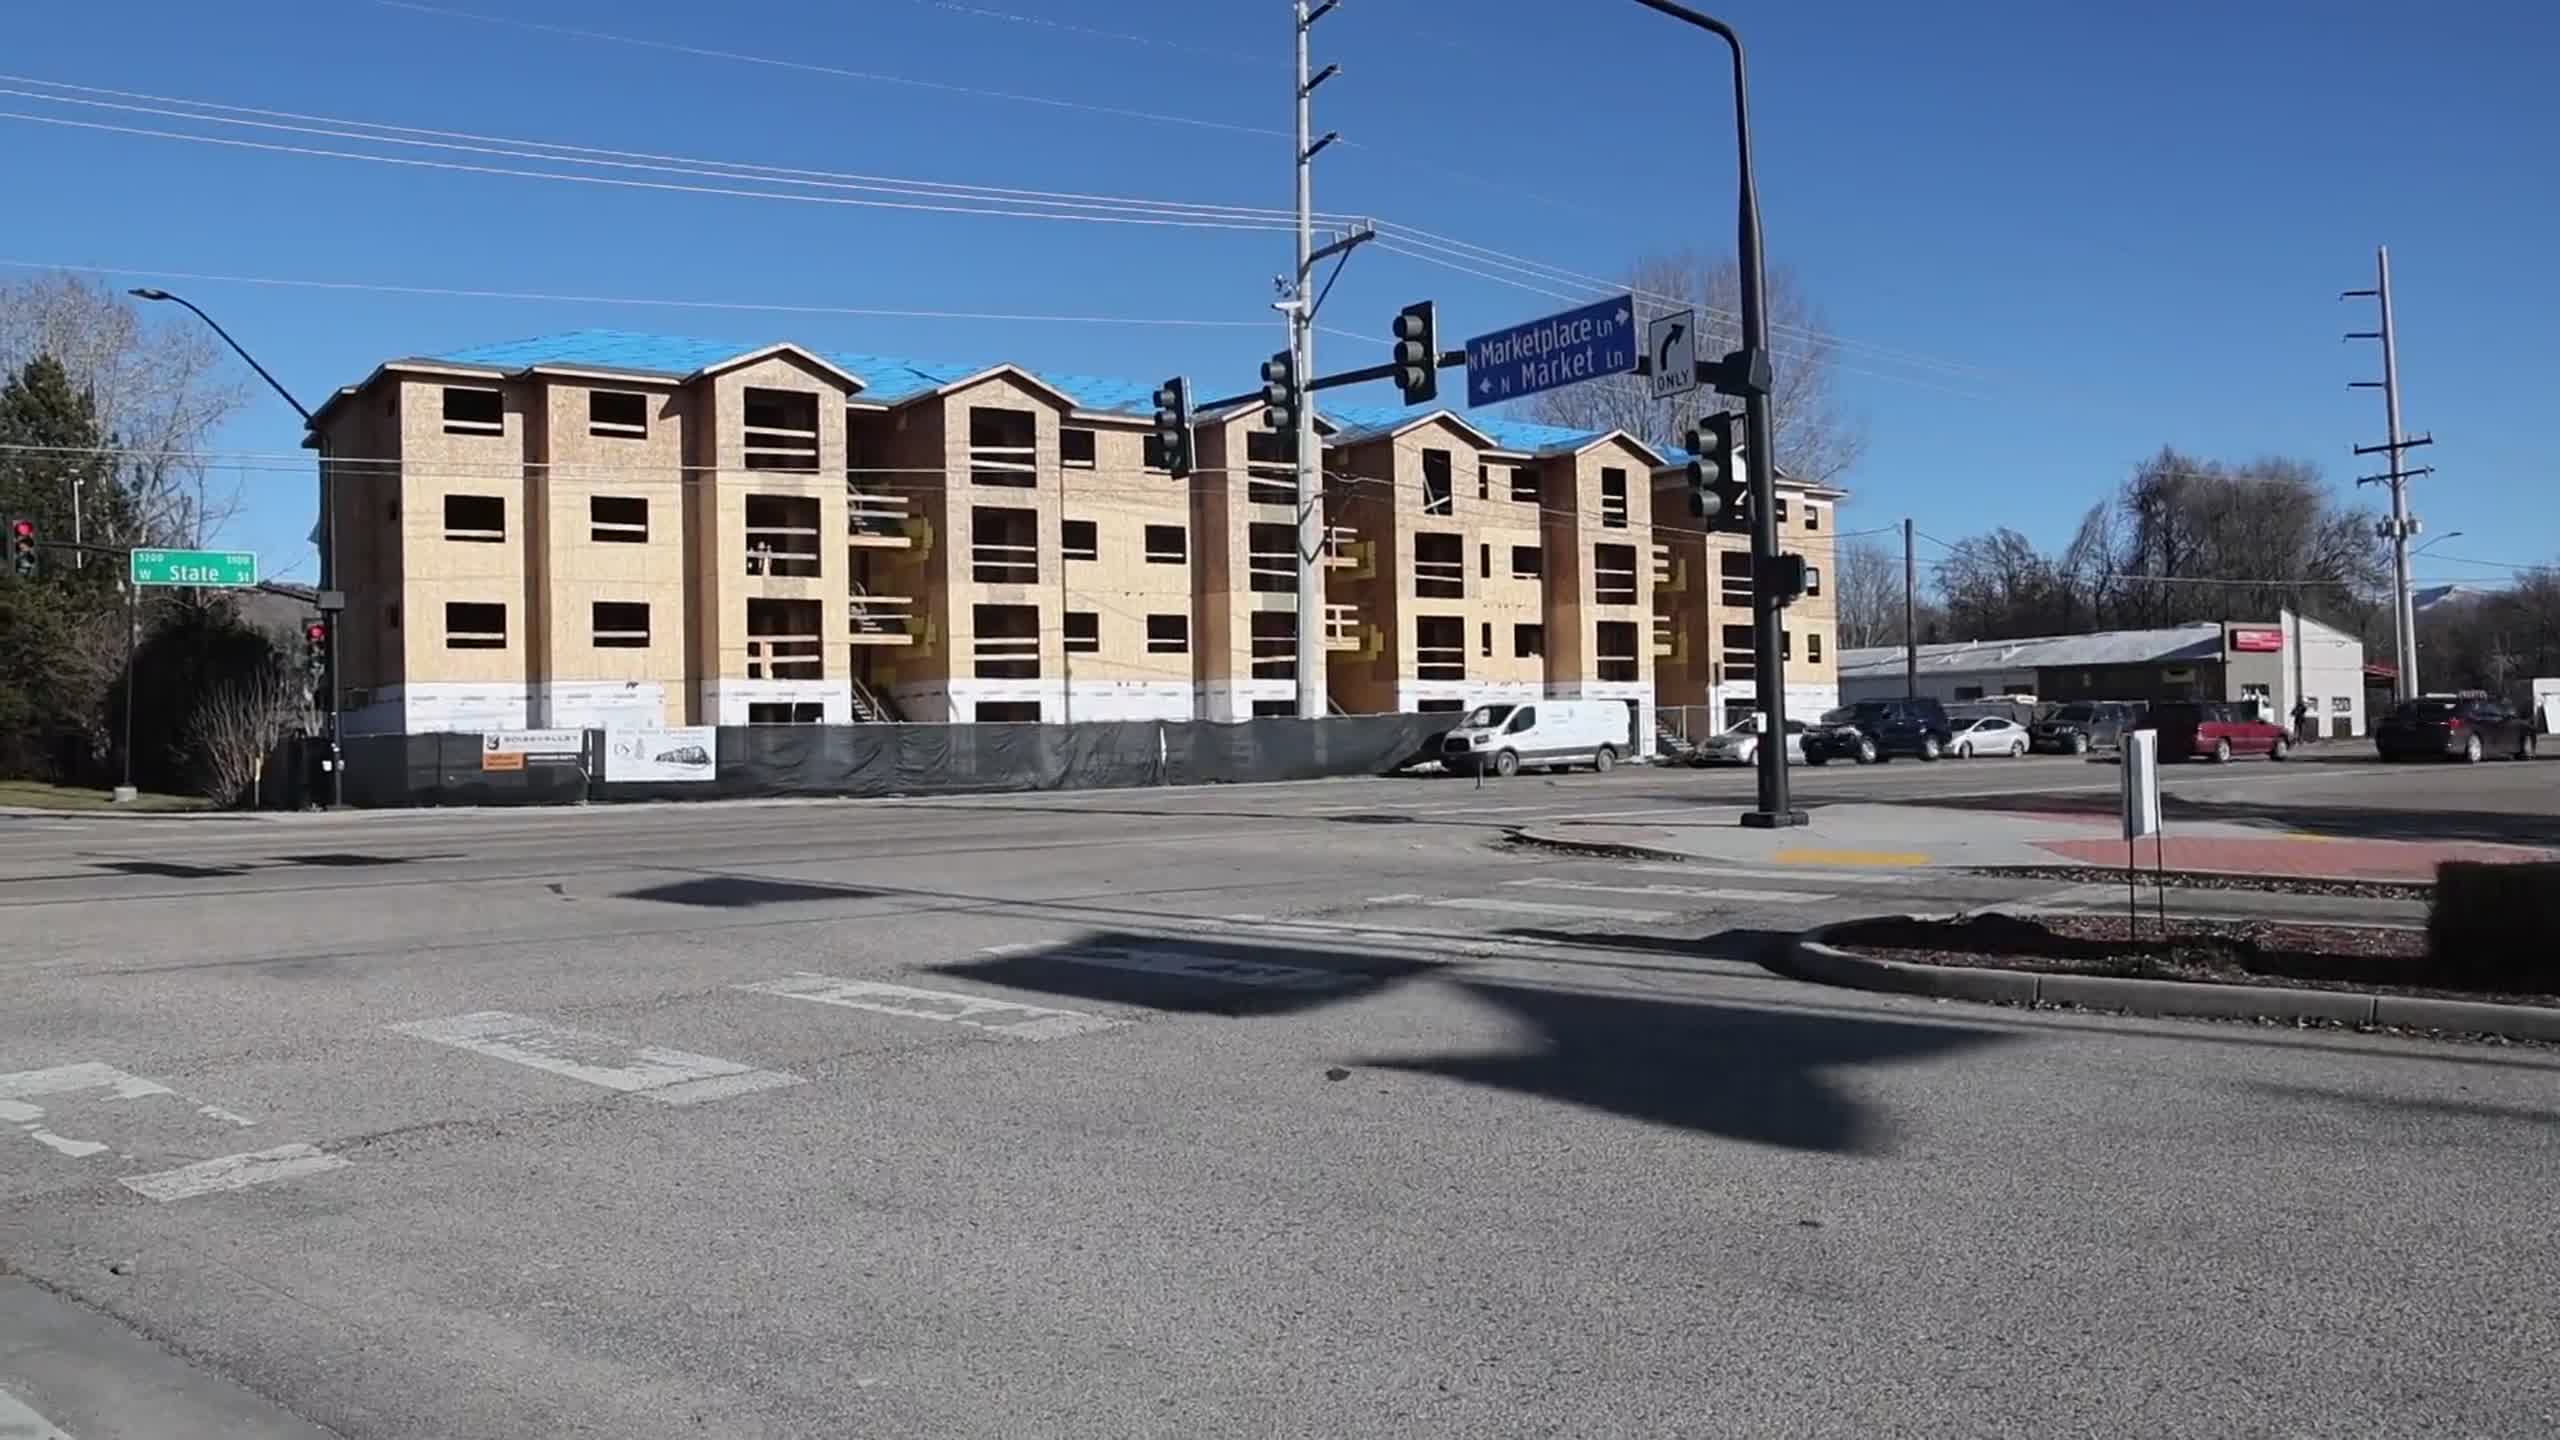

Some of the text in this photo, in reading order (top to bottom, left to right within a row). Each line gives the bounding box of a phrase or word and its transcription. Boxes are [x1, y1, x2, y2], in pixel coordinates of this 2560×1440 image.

[1469, 318, 1614, 372] N Marketplace Ln
[1500, 347, 1623, 395] N Market Ln
[1657, 370, 1689, 392] ONLY
[138, 565, 249, 582] W State St
